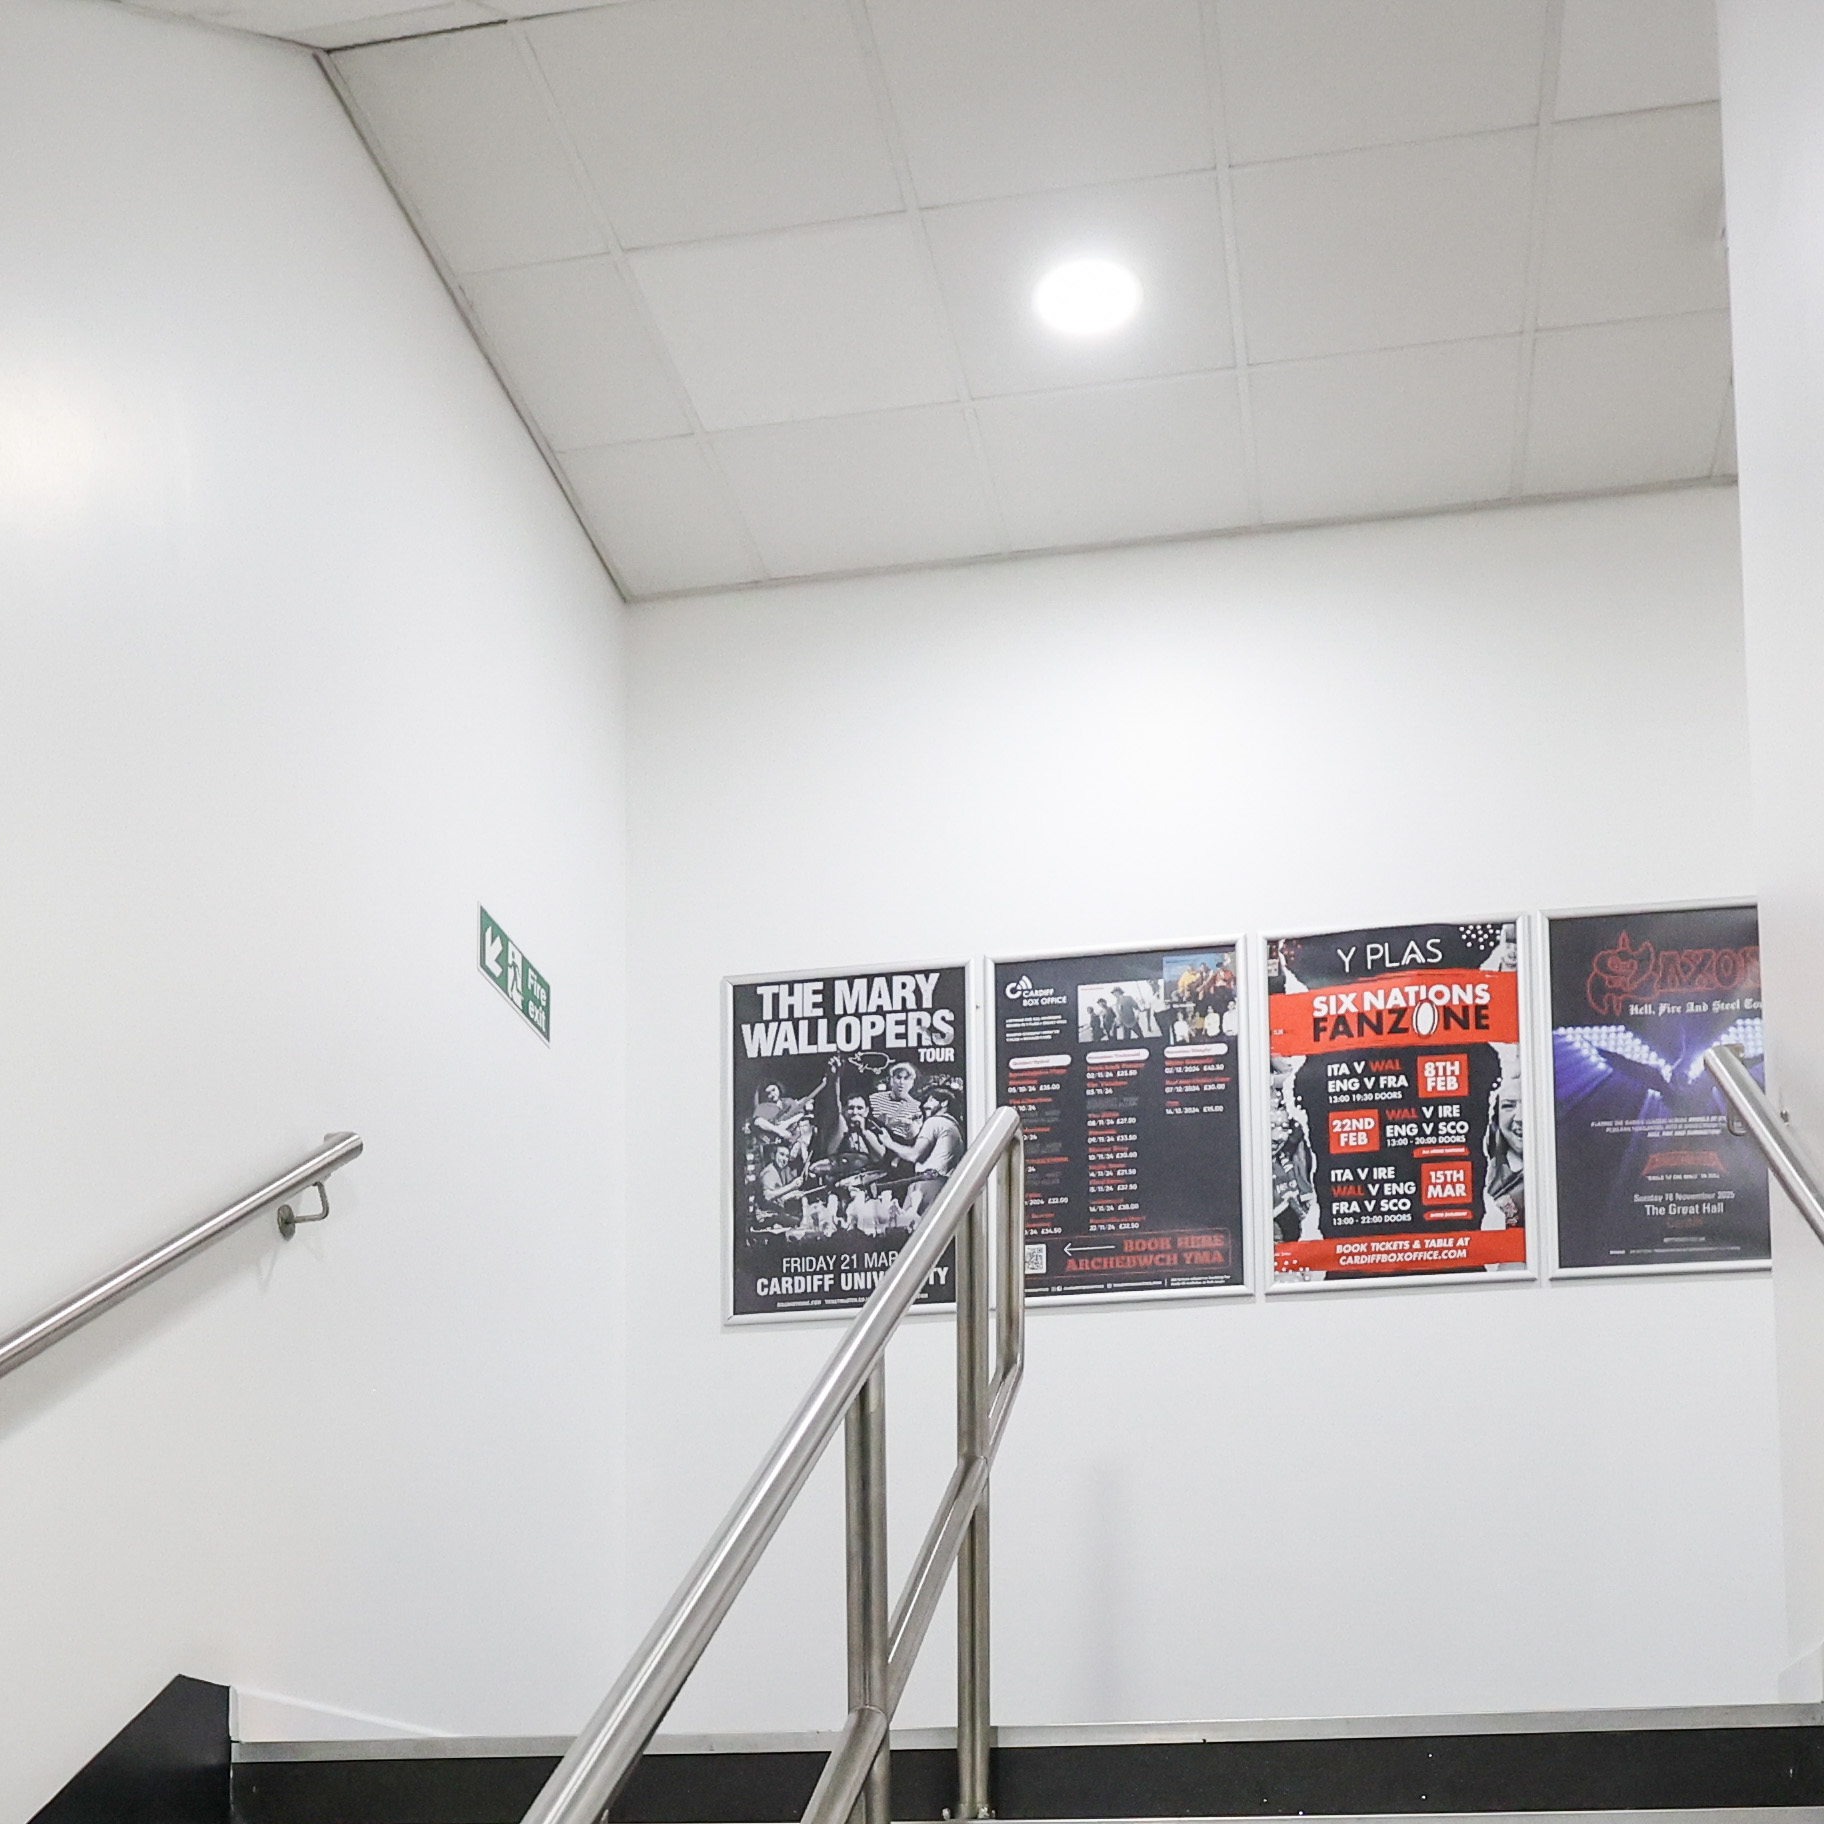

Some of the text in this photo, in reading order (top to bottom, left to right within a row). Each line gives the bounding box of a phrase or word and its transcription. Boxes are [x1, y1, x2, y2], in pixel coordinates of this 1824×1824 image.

[1337, 938, 1443, 973] Y PLAS
[528, 967, 547, 1007] Fire
[1023, 987, 1054, 998] CARDIFF
[756, 972, 940, 1020] THE MARY
[1023, 995, 1067, 1007] BOX OFFICE
[1313, 983, 1491, 1018] SIX NATIONS
[1629, 1004, 1656, 1016] Hell,
[1658, 1002, 1681, 1016] Fire
[1685, 1001, 1709, 1013] And
[1712, 998, 1740, 1014] Steel
[528, 1000, 546, 1032] exit
[1313, 1002, 1490, 1042] FANZONE
[741, 1009, 955, 1058] WALLOPERS
[918, 1048, 955, 1063] TOUR
[1327, 1059, 1403, 1077] ITA V WAL
[1423, 1061, 1460, 1077] 8TH
[1327, 1075, 1409, 1093] ENG V FRA
[1426, 1076, 1459, 1092] FEB
[1328, 1091, 1402, 1104] 13:00 19:30 DOORS
[1385, 1105, 1461, 1120] WAL V IRE
[1332, 1117, 1375, 1132] 22ND
[1386, 1121, 1469, 1137] ENG V SCO
[1339, 1132, 1368, 1147] FEB
[1386, 1137, 1408, 1147] 13:00
[1415, 1136, 1436, 1145] 20:00
[1438, 1135, 1466, 1144] DOORS
[1330, 1166, 1395, 1182] ITA V IRE
[1429, 1169, 1464, 1184] 15TH
[1331, 1181, 1416, 1197] WAL V ENG
[1427, 1183, 1467, 1199] MAR
[1332, 1198, 1411, 1215] FRA V SCO
[1644, 1201, 1724, 1217] The Great Hall
[1332, 1217, 1354, 1226] 13:00
[1360, 1215, 1382, 1224] 22:00
[1384, 1213, 1412, 1222] DOORS
[1122, 1234, 1225, 1253] BOOK HERE
[1336, 1237, 1470, 1254] BOOK TICKETS & TABLE AT
[782, 1250, 900, 1274] FRIDAY 21 MAR
[1183, 1250, 1224, 1264] YMA
[1339, 1249, 1467, 1266] CARDIFFBOXOFFICE.COM
[756, 1266, 949, 1296] CARDIFF UNIVTY
